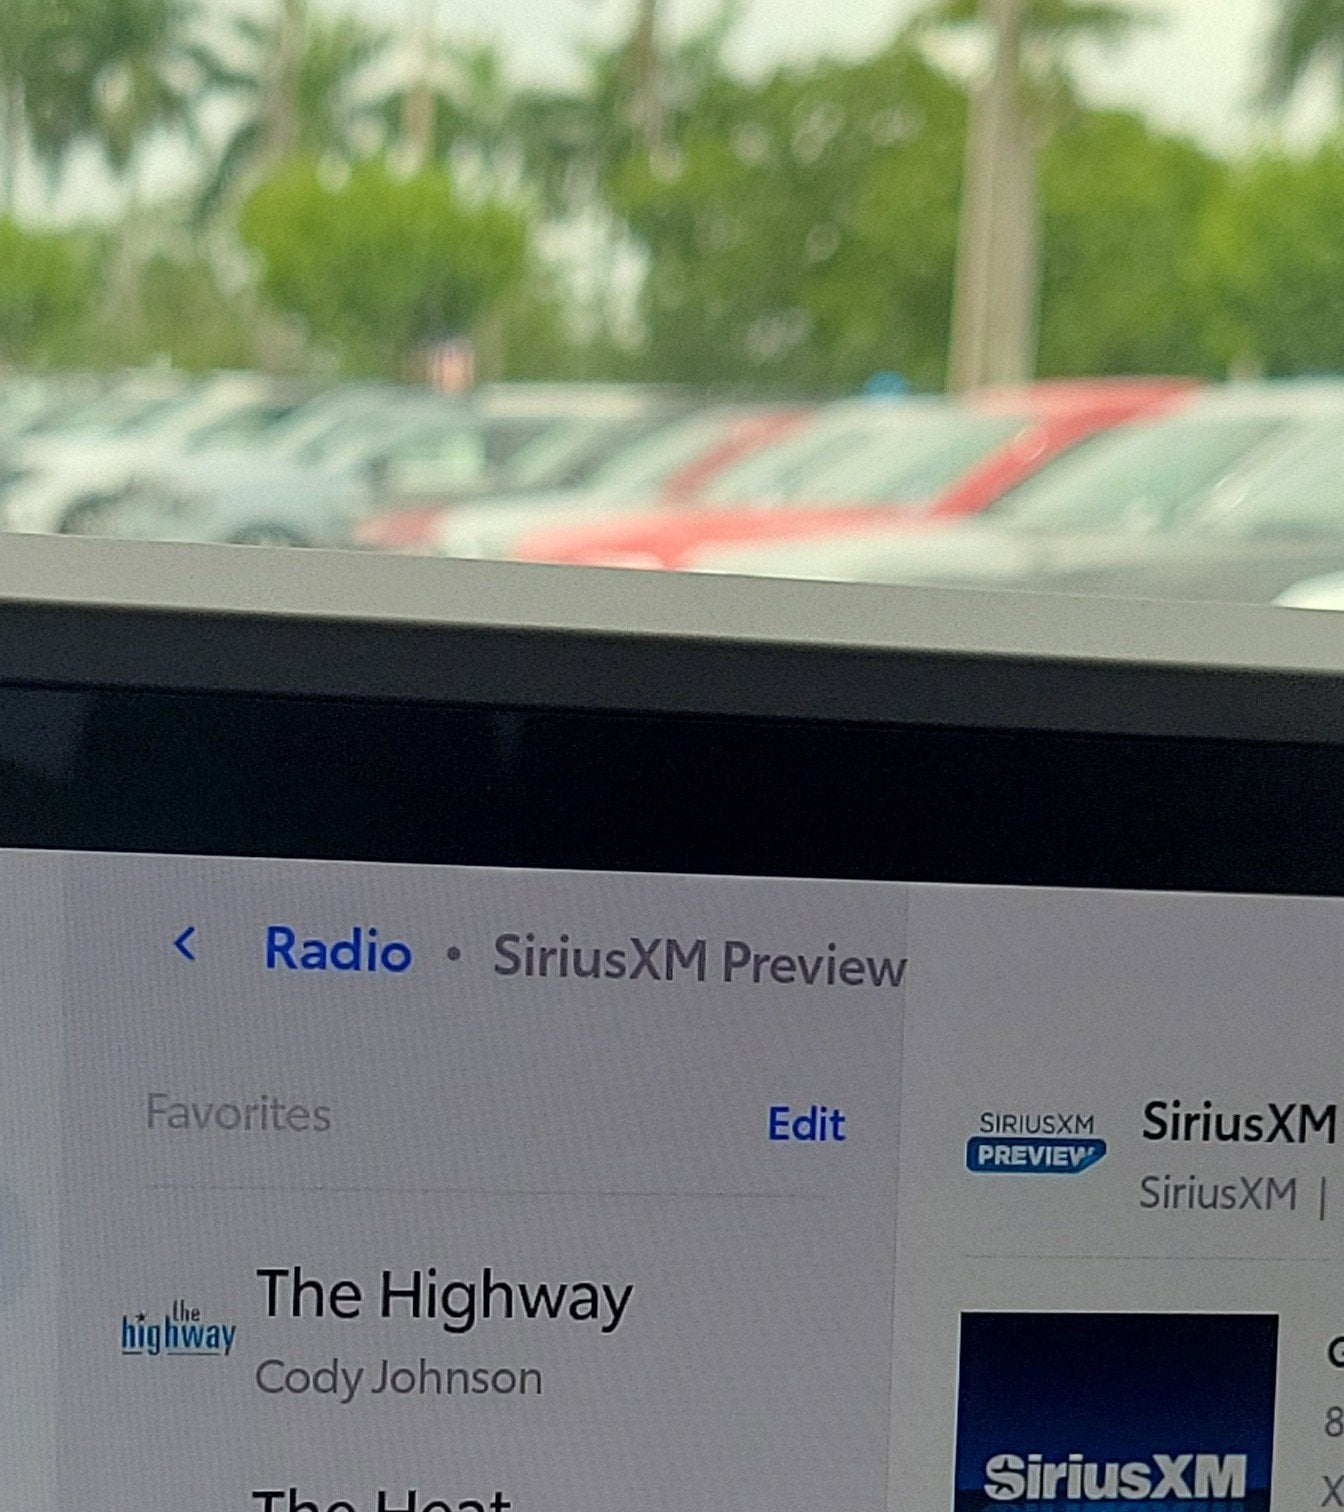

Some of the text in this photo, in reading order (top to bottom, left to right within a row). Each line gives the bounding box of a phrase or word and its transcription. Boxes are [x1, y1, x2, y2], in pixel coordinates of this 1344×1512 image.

[265, 925, 908, 989] Radio SiriusXM Preview
[146, 1092, 332, 1134] Favorites
[768, 1104, 847, 1143] Edit
[979, 1111, 1095, 1135] SIRIUSXM
[1142, 1098, 1337, 1145] SiriusXM
[978, 1143, 1095, 1168] PREVIEW
[1138, 1172, 1299, 1212] SiriusXM
[172, 1299, 201, 1322] the
[255, 1264, 634, 1335] The Highway
[121, 1314, 237, 1356] highway
[254, 1356, 543, 1405] Cody Johnson
[983, 1453, 1248, 1501] SiriusXM
